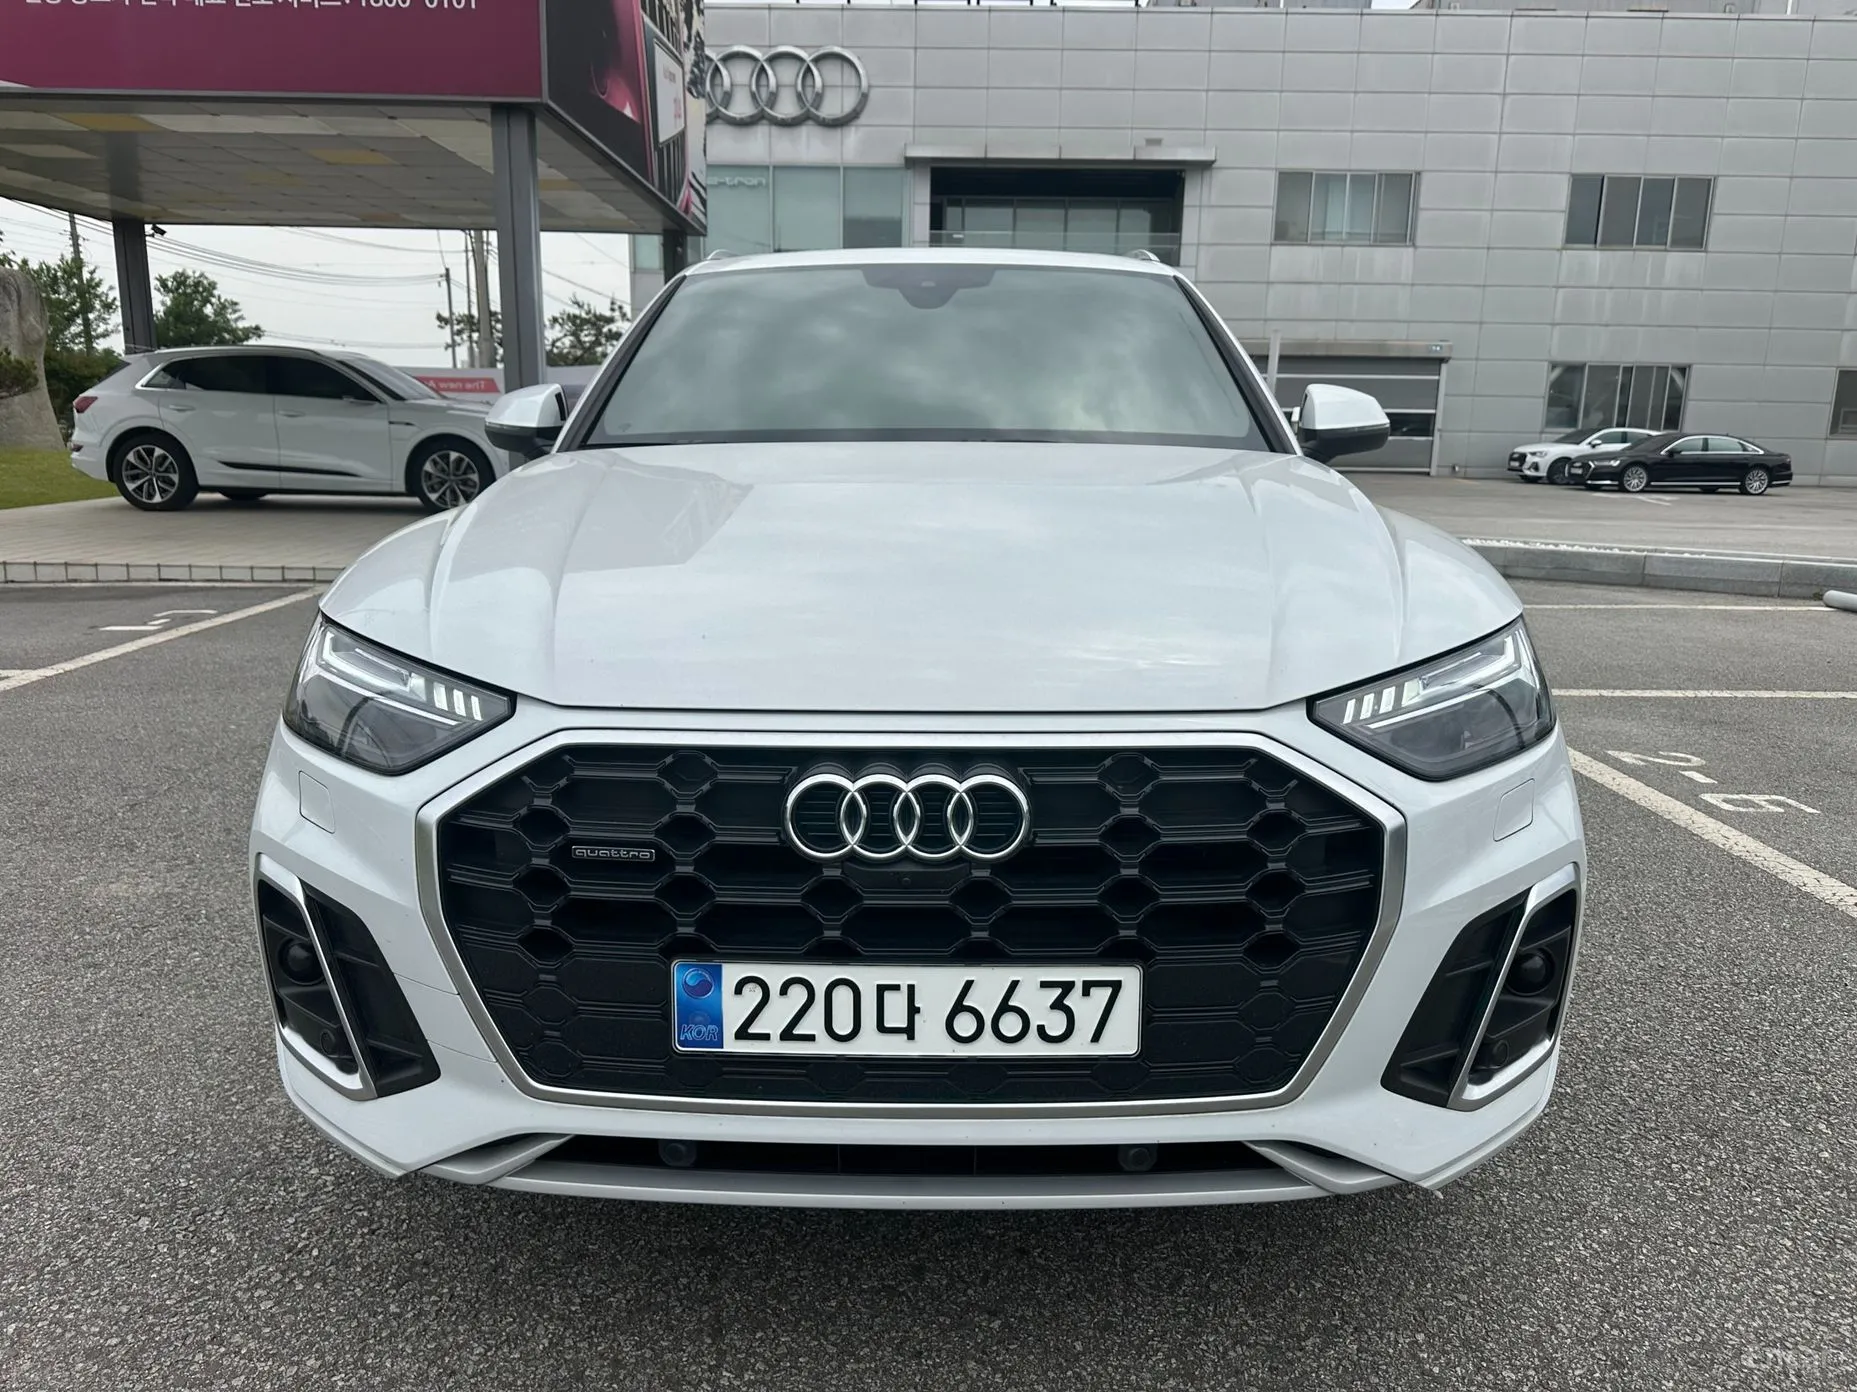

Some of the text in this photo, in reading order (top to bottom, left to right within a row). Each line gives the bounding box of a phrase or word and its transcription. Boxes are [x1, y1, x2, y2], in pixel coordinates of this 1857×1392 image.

[575, 848, 651, 859] quattro
[733, 975, 1123, 1044] 220다 6637
[679, 1023, 720, 1042] KOR
